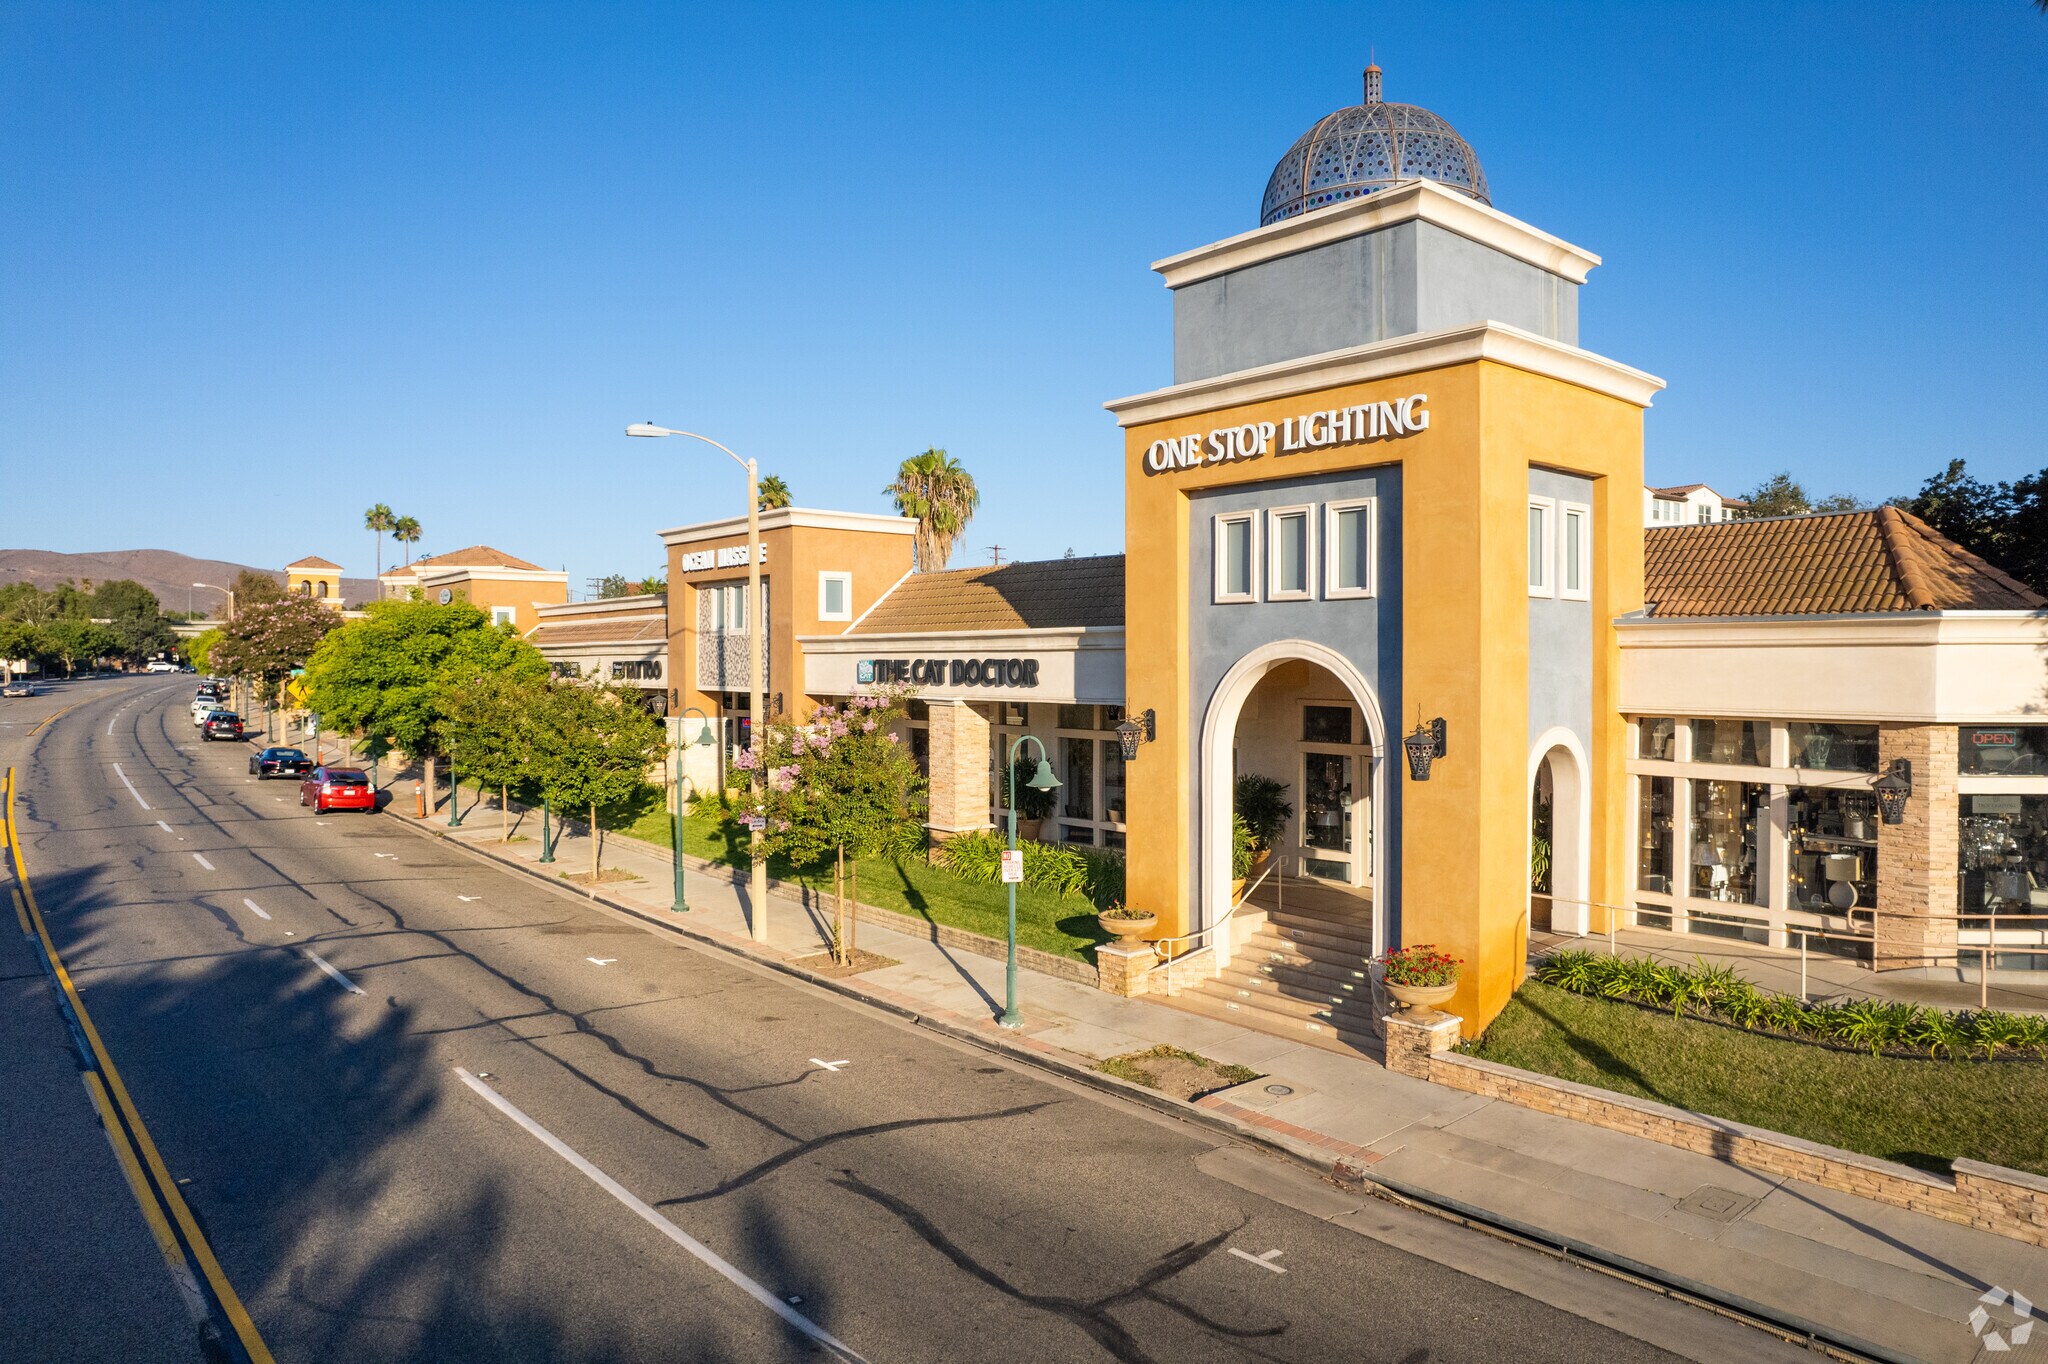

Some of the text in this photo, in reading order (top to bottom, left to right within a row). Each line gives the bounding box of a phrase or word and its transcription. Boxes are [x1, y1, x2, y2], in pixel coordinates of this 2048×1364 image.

[1149, 393, 1431, 472] ONE STOP LIGHTING
[682, 543, 767, 572] OCEAN MASSAE
[875, 658, 1040, 686] THE CAT DOCTOR
[1972, 733, 2014, 744] OPEN
